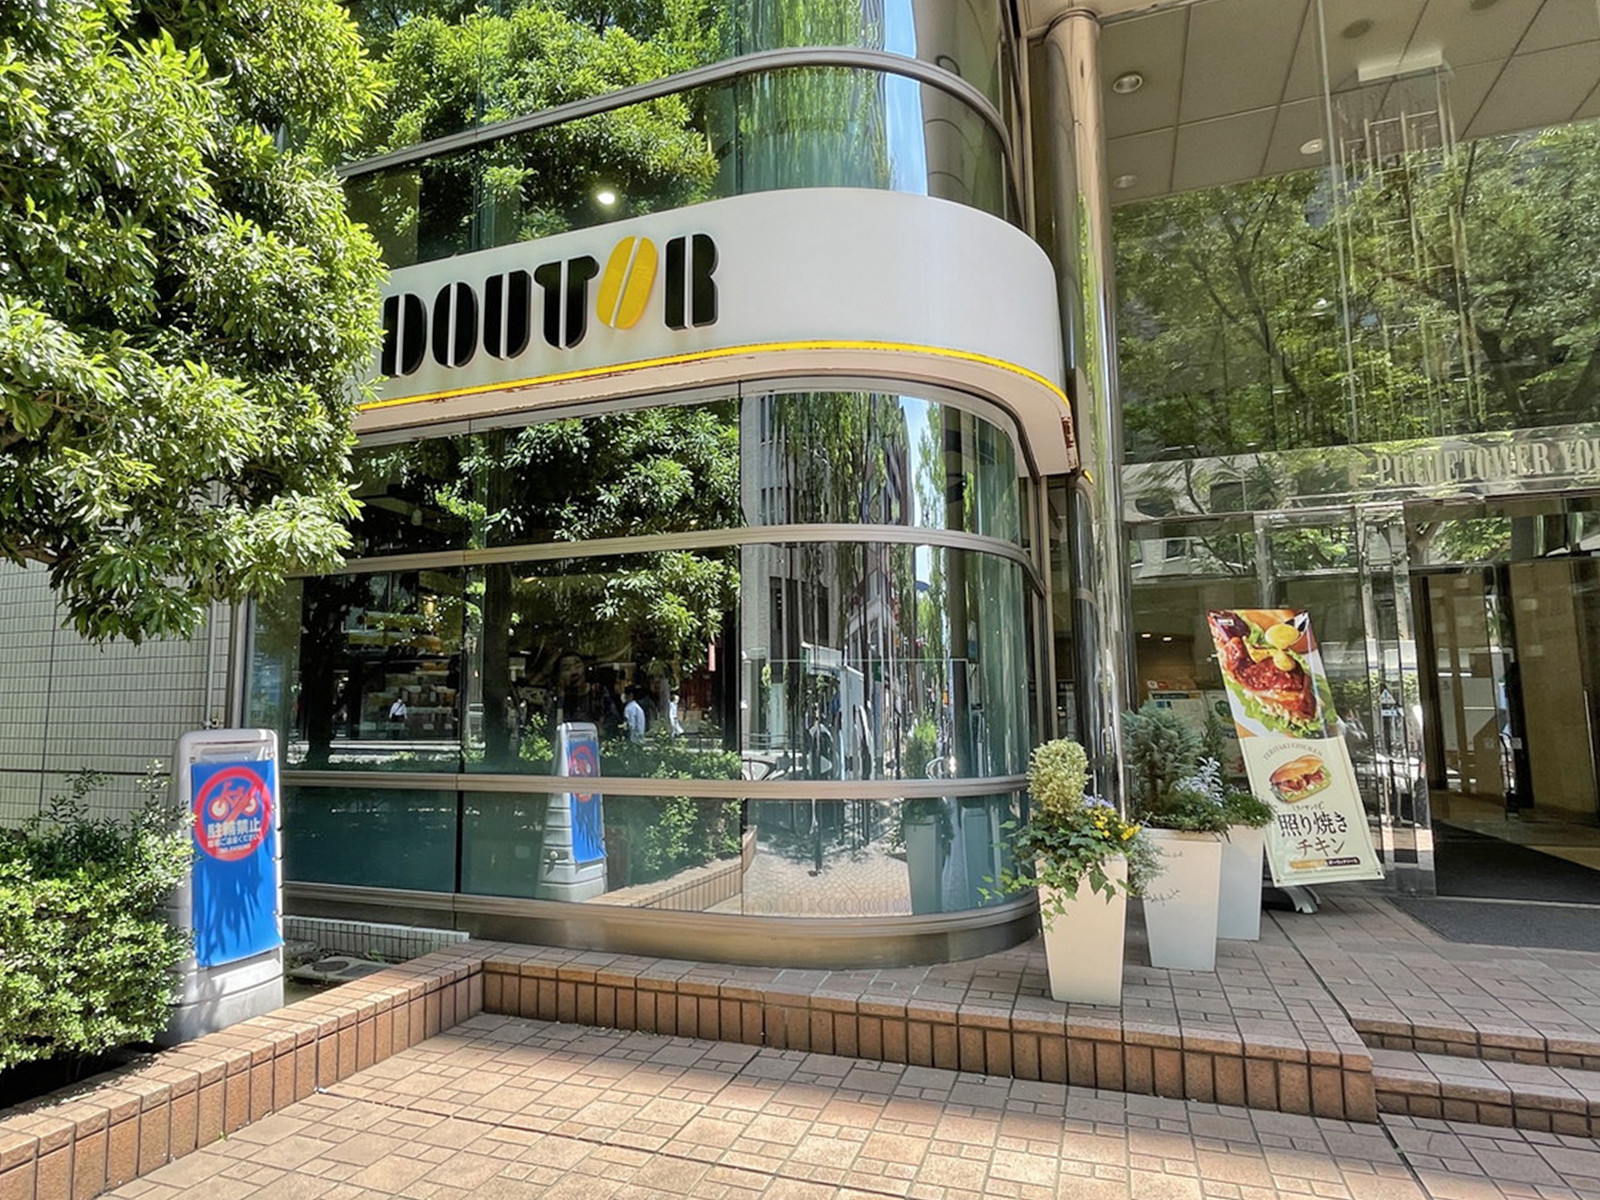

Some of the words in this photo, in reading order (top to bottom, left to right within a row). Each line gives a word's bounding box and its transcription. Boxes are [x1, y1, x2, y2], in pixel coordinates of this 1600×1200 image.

[380, 233, 719, 378] DOUTOR
[1277, 811, 1348, 838] 照り焼き
[1296, 836, 1345, 857] チキン
